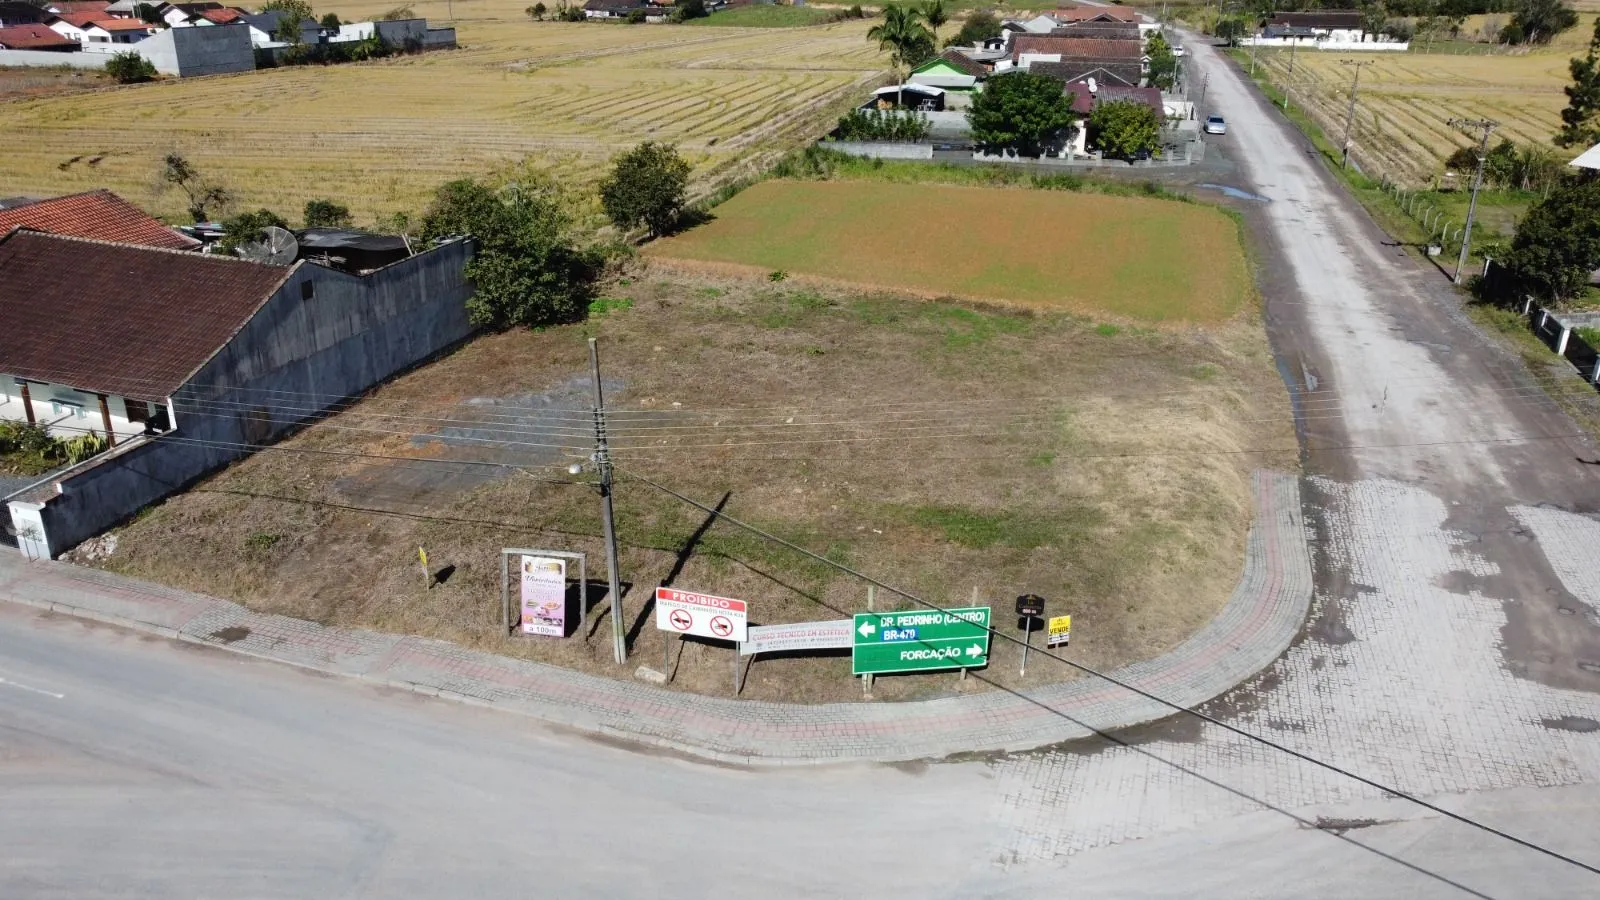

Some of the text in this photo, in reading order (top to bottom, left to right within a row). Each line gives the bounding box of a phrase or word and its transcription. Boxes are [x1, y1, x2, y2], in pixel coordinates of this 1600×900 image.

[673, 593, 729, 608] PROIBIDO
[880, 612, 985, 627] DR. PEDRINHO (CENTRO)
[753, 632, 775, 641] CURSO
[807, 629, 817, 637] EM
[883, 629, 916, 641] BR-470
[900, 647, 961, 661] FORCAÇÃO
